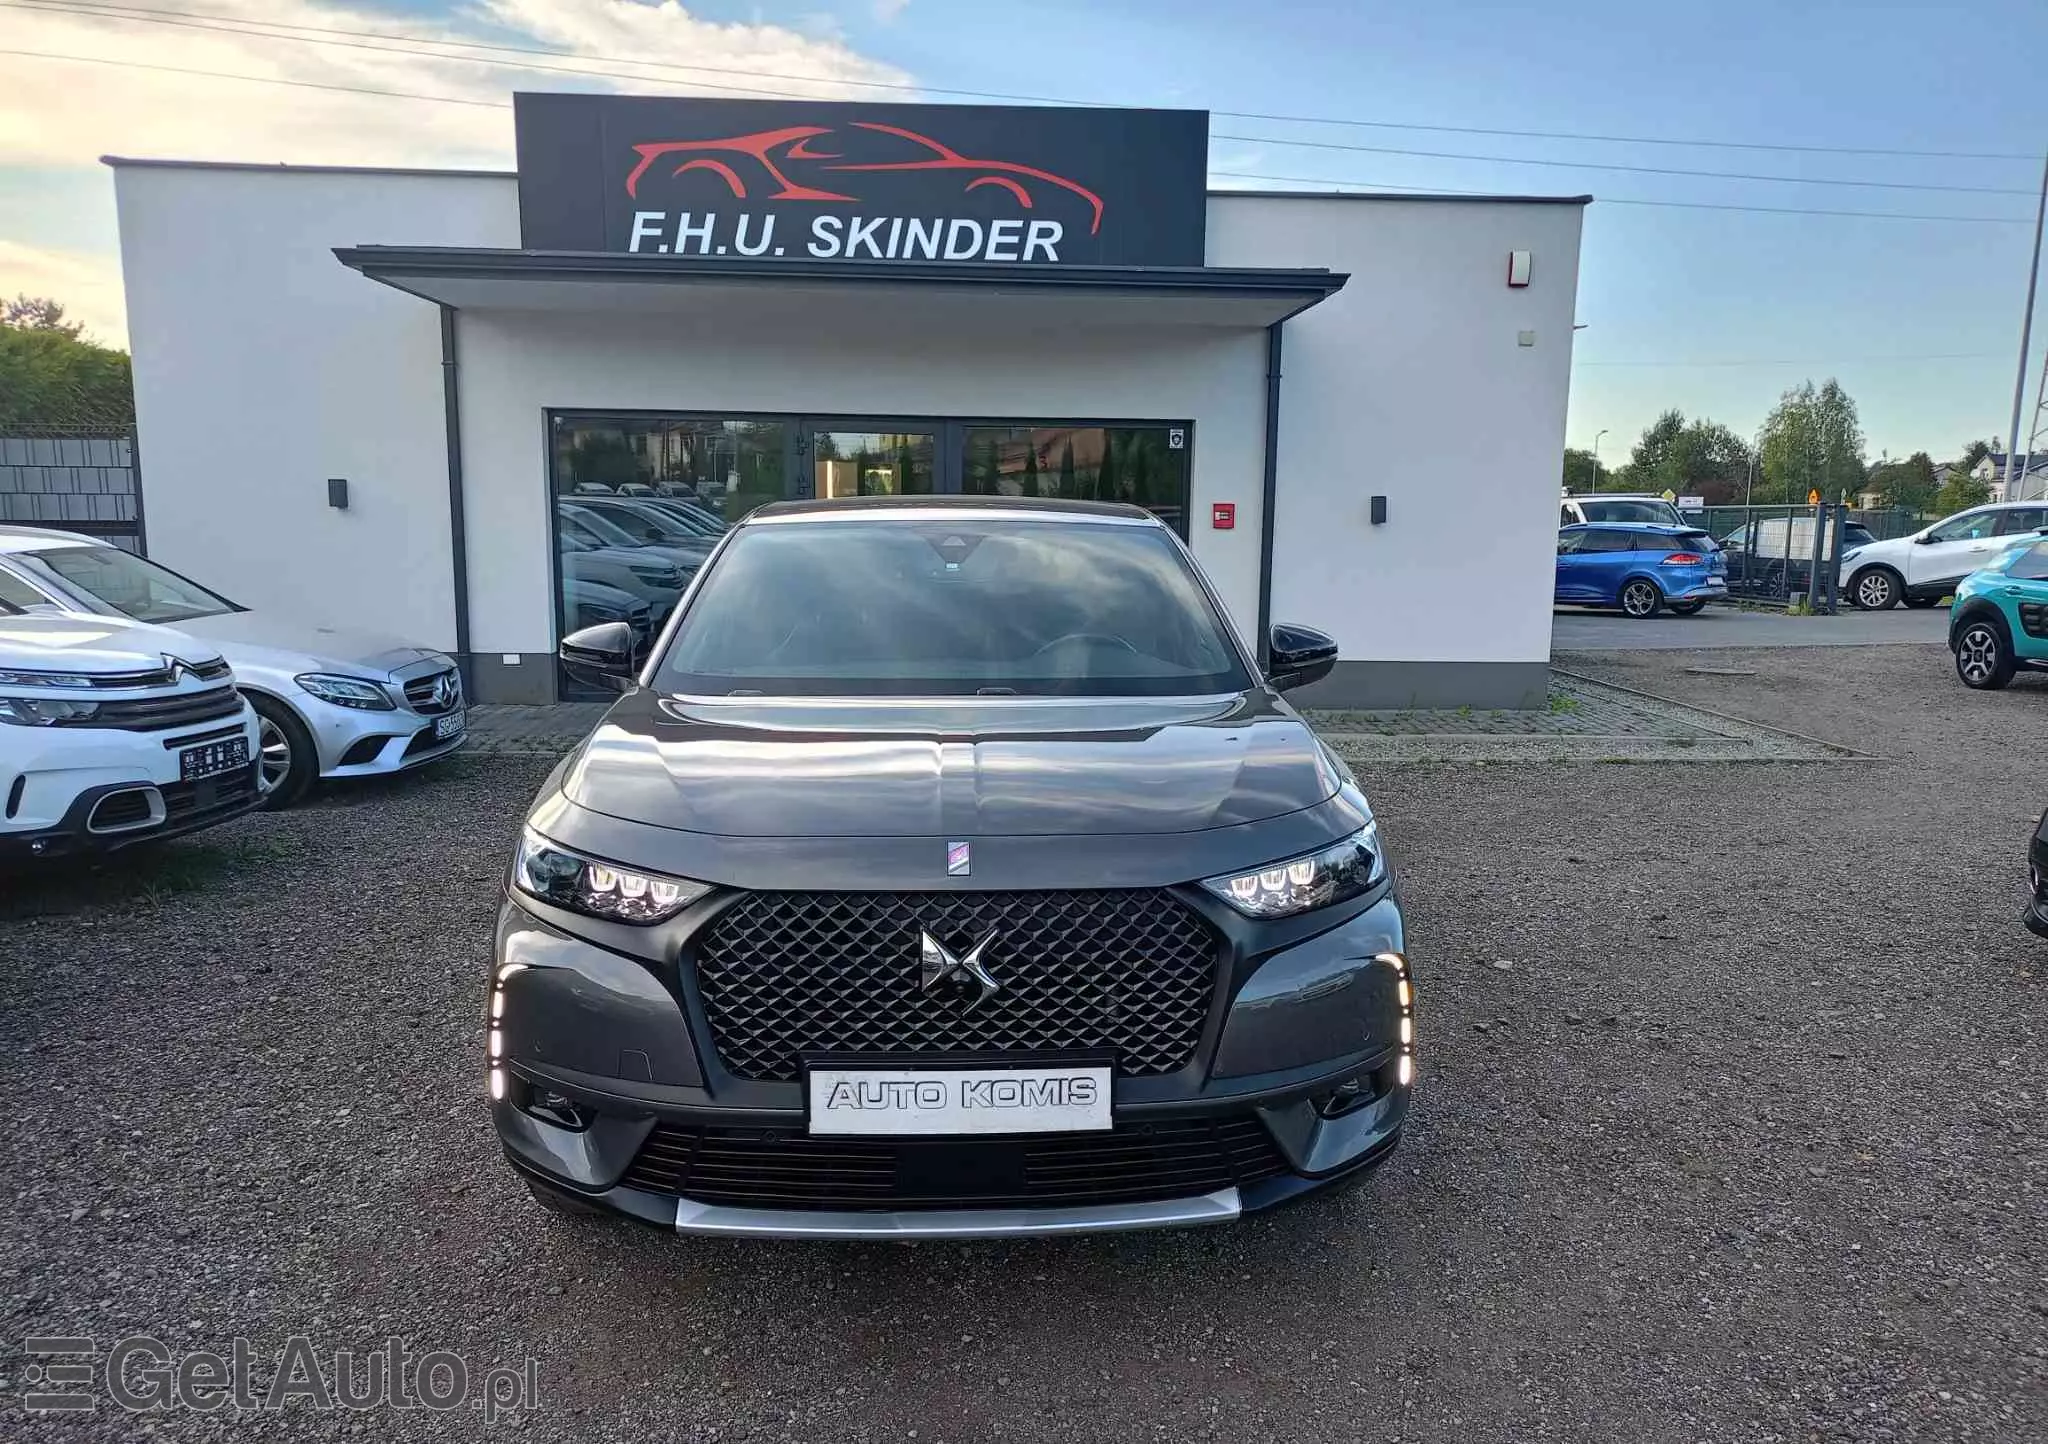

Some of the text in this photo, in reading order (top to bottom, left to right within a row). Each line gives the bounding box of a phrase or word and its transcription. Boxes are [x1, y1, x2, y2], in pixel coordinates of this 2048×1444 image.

[628, 211, 1063, 262] F.H.U. SKINDER
[827, 1077, 1098, 1110] AUTO KOMIS
